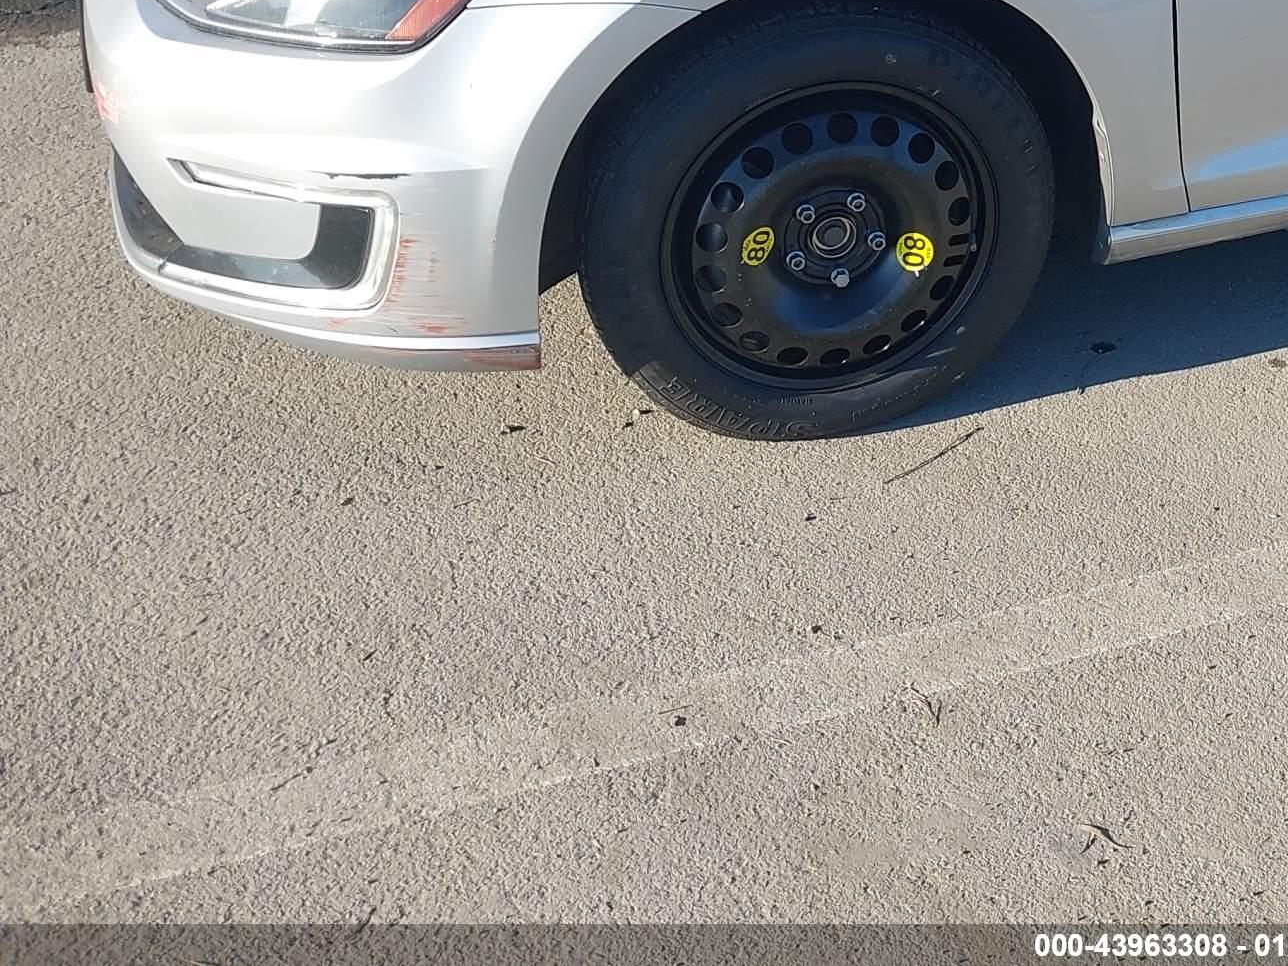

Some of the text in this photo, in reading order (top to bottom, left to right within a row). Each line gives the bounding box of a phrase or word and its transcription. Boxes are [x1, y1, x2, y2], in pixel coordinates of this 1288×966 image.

[747, 230, 771, 262] 80
[902, 235, 926, 267] 80
[658, 376, 819, 438] SPARE
